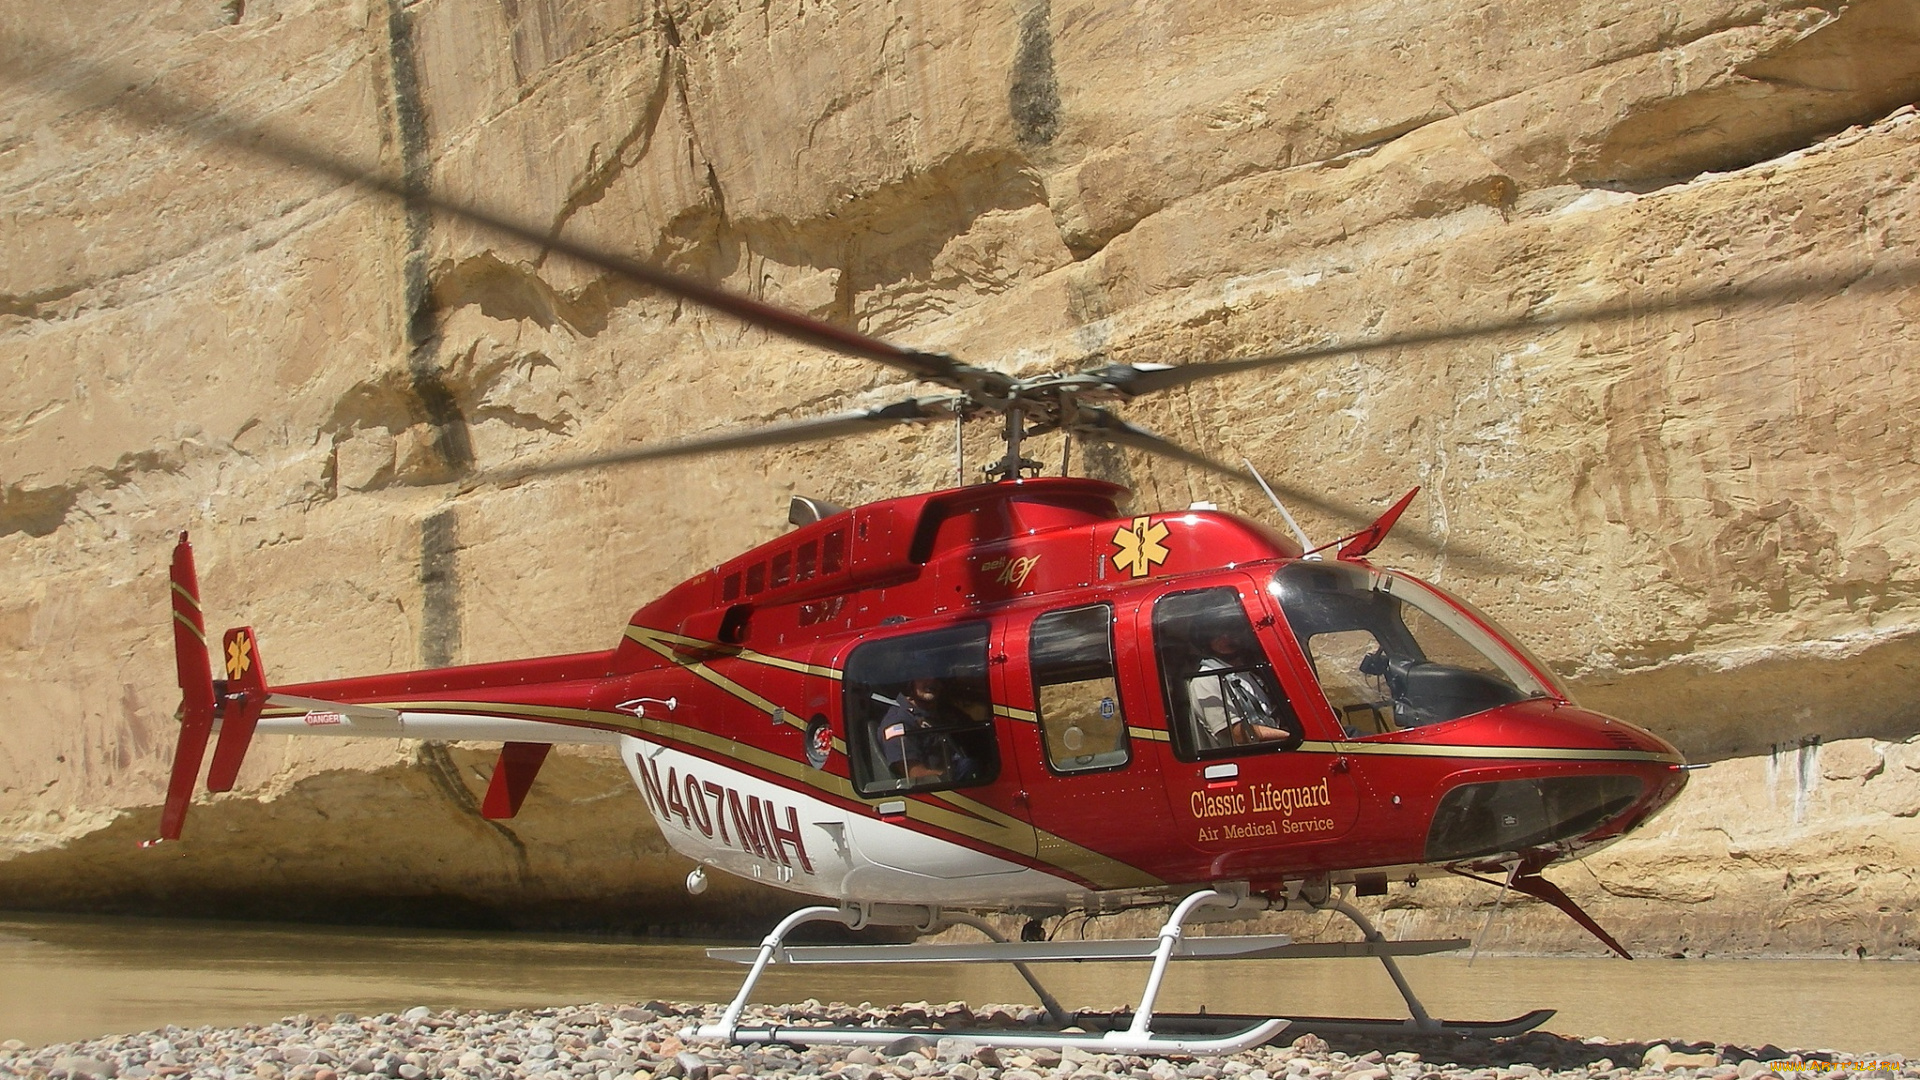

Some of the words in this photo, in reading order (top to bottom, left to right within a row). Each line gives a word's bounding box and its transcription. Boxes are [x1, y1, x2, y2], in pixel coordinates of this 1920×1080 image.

[996, 554, 1042, 589] 407
[307, 714, 339, 724] DANGER
[635, 752, 815, 875] N407MH
[1190, 787, 1246, 818] Classic
[1249, 776, 1331, 817] Lifeguard
[1197, 827, 1219, 842] Air
[1223, 820, 1278, 839] Medical
[1281, 816, 1335, 834] Service
